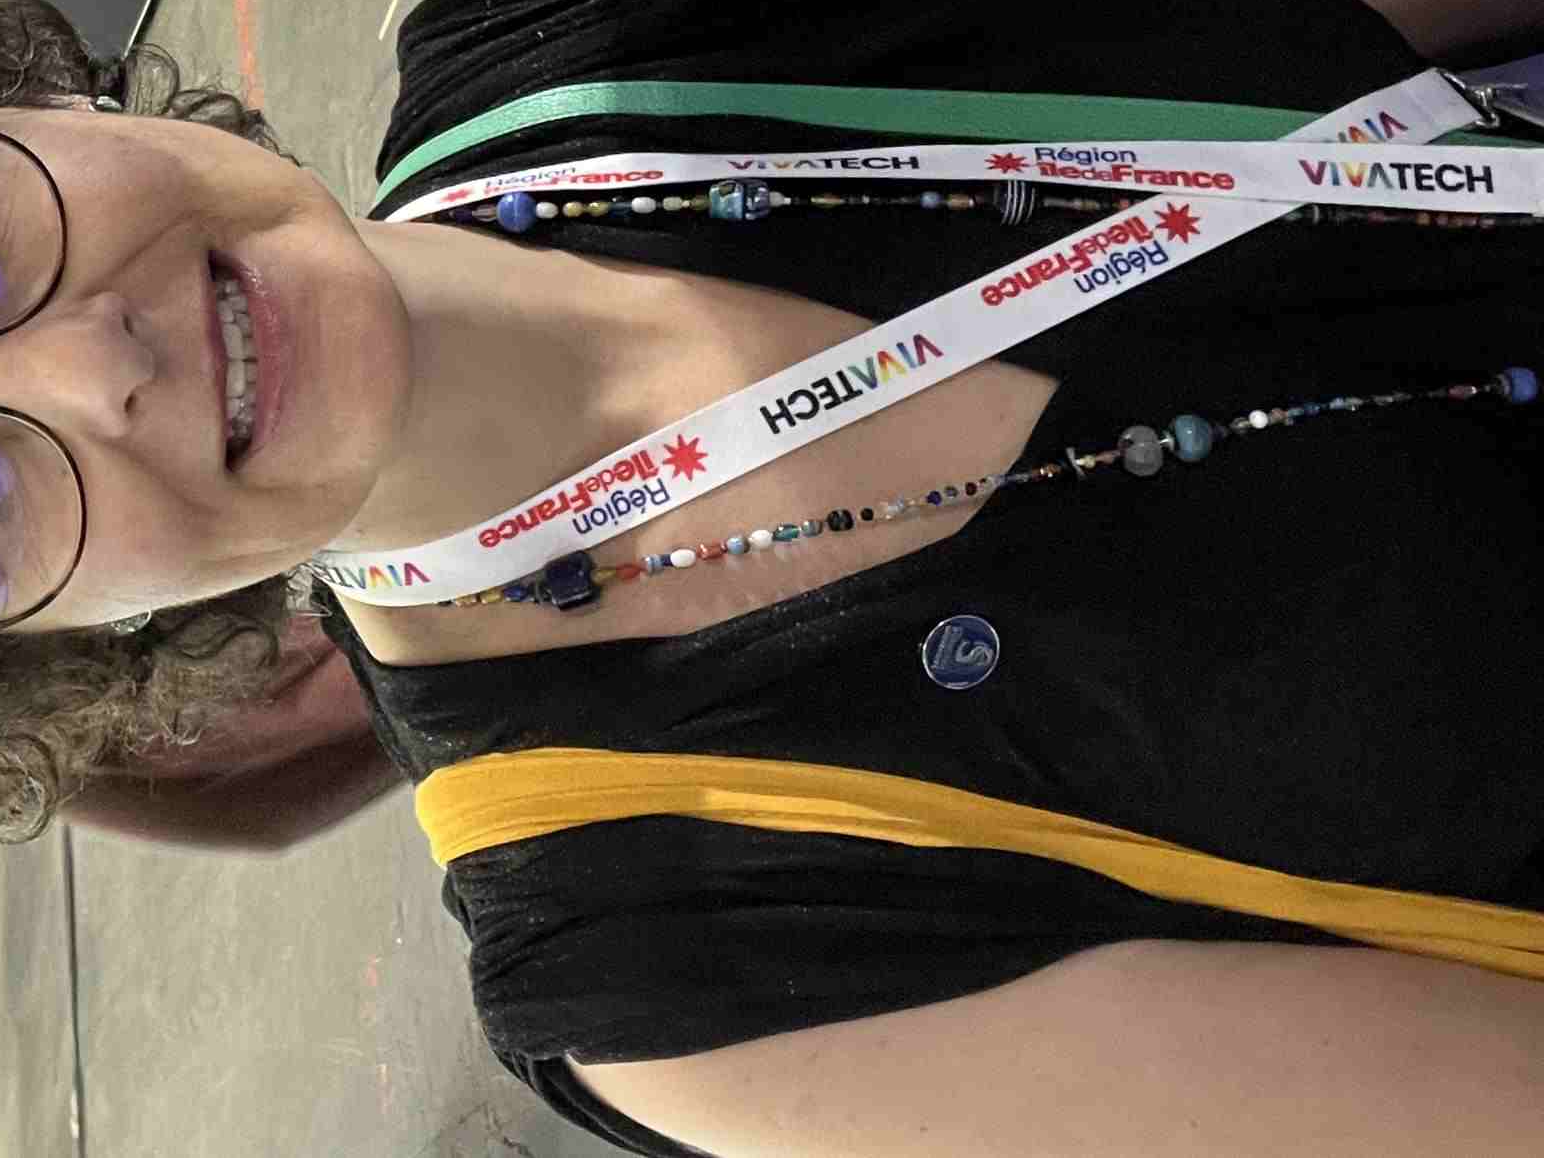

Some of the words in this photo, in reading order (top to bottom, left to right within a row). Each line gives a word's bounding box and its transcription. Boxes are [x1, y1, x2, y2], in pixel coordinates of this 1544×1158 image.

[1034, 147, 1138, 162] Région
[1298, 159, 1494, 193] VIVATECH
[1073, 240, 1169, 294] Région
[759, 333, 944, 435] VIVATECH
[571, 478, 671, 535] Région
